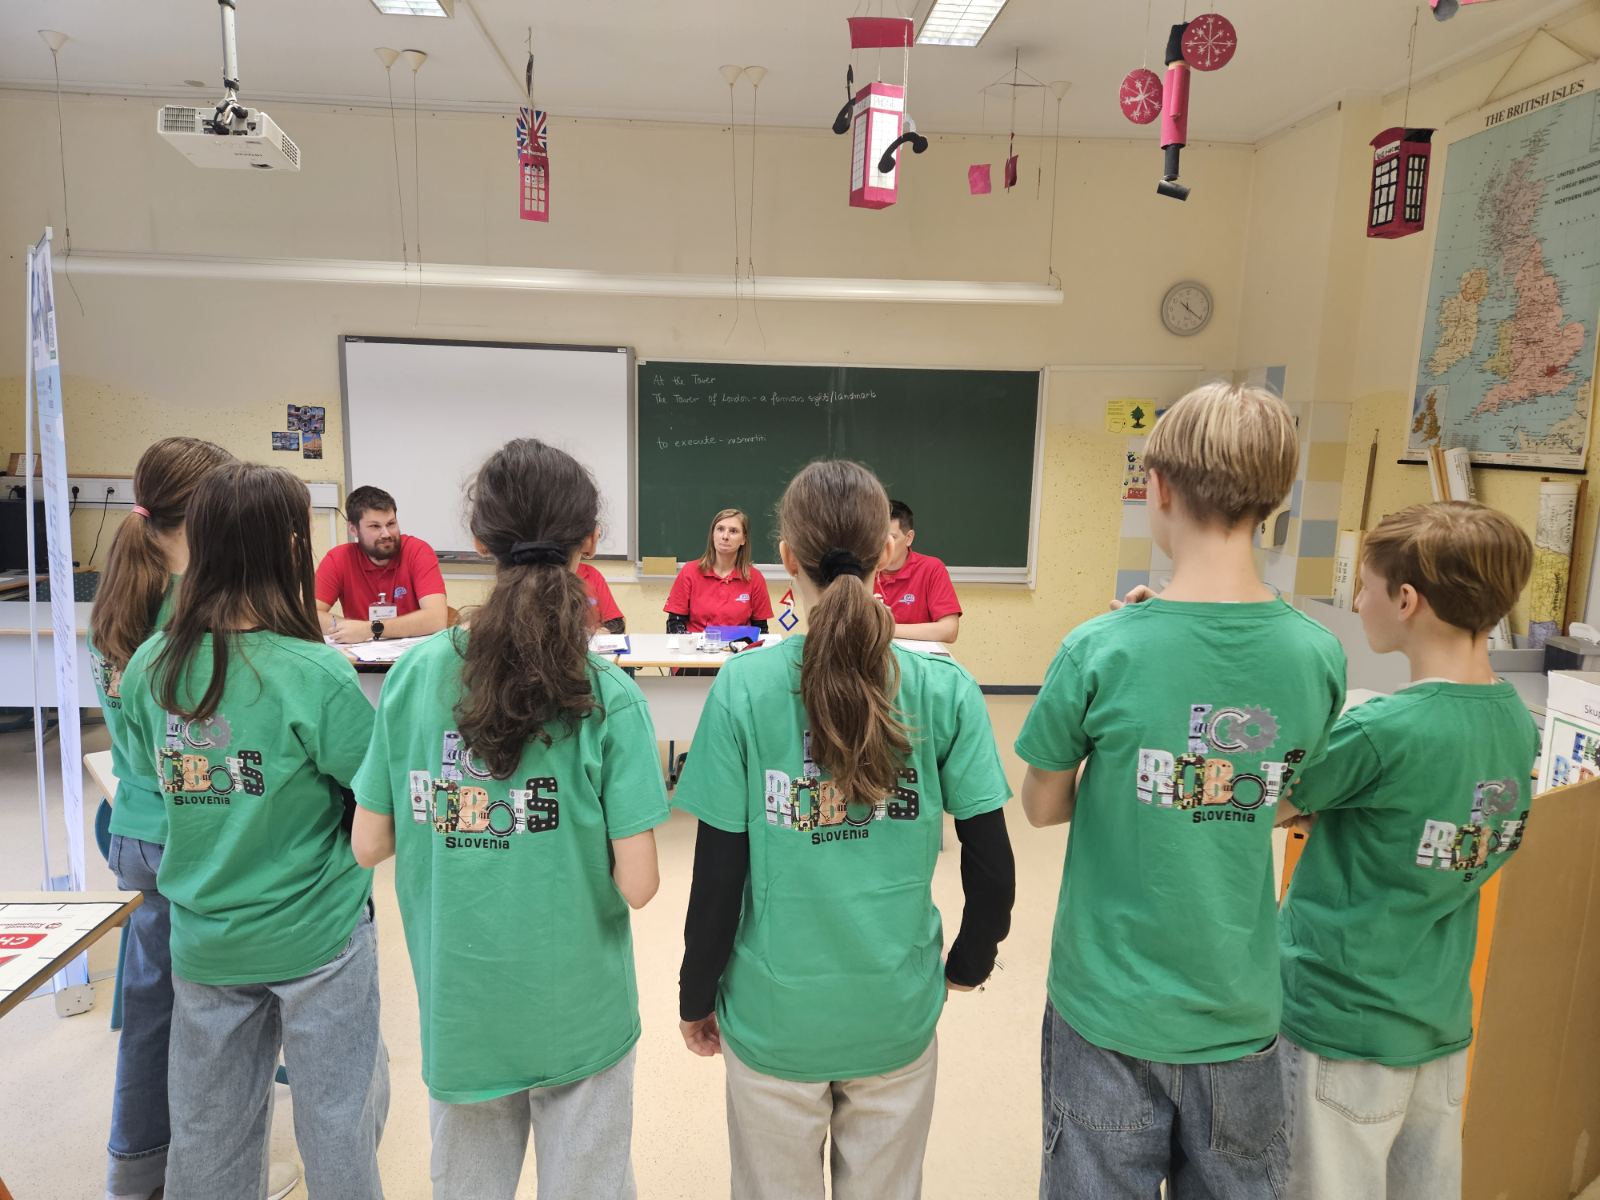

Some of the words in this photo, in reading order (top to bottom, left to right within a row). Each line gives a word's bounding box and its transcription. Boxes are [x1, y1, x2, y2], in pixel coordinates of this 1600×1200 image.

[1485, 110, 1505, 127] THE
[1506, 92, 1549, 119] BRITISH
[1551, 79, 1585, 102] ISLES
[653, 374, 665, 386] At
[671, 375, 684, 385] the
[690, 373, 716, 384] Tower
[651, 392, 666, 404] The
[672, 393, 700, 404] Tower
[708, 392, 718, 407] of
[722, 392, 750, 403] London
[770, 390, 805, 406] famous
[655, 435, 668, 450] to
[674, 435, 716, 448] execute
